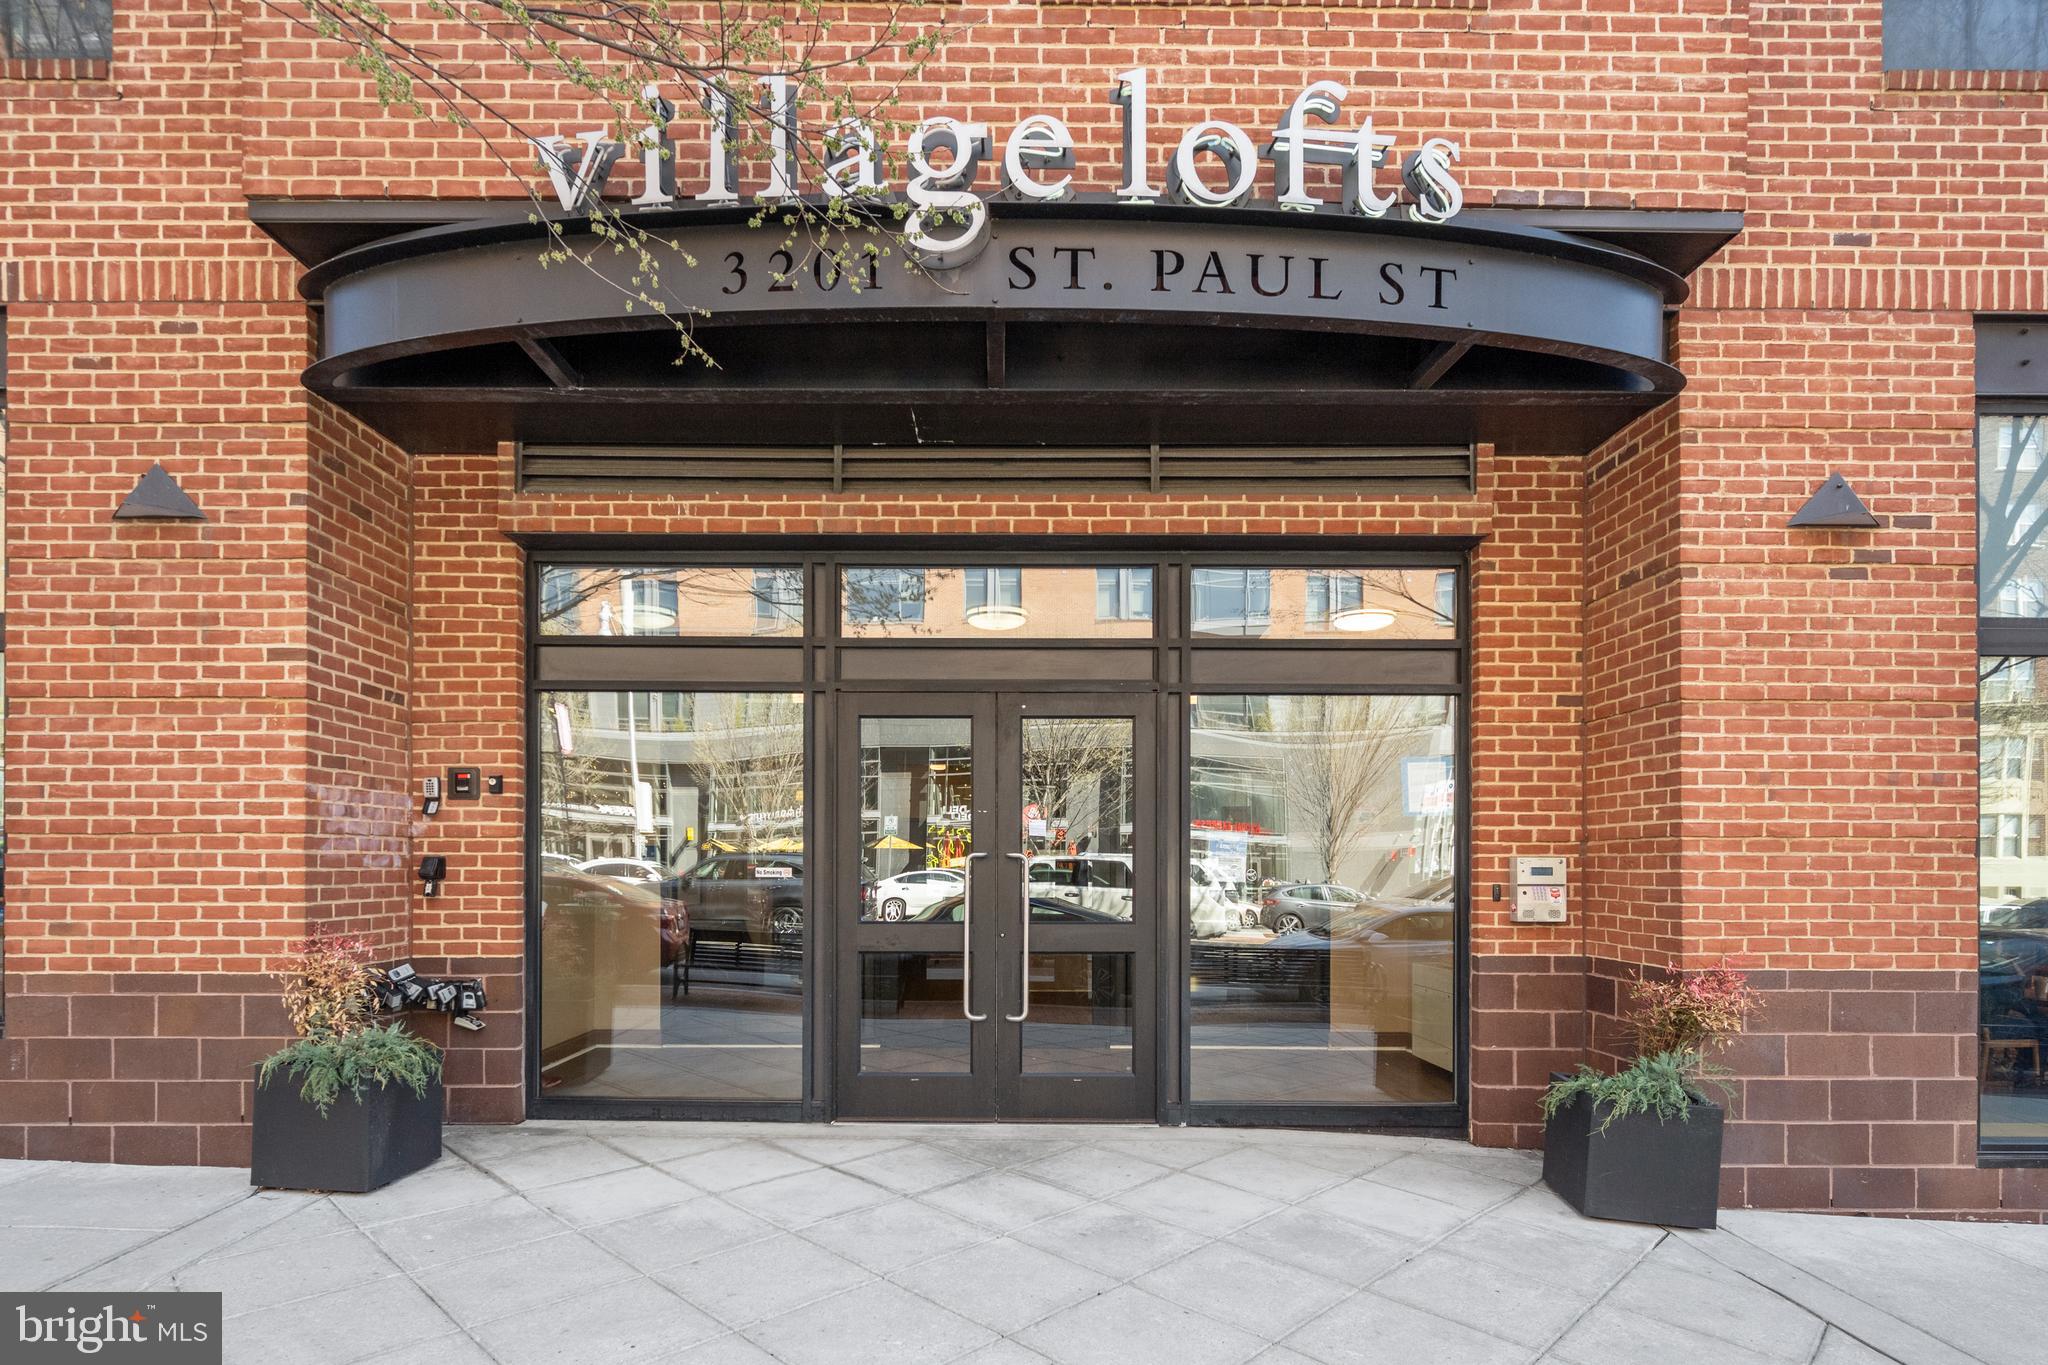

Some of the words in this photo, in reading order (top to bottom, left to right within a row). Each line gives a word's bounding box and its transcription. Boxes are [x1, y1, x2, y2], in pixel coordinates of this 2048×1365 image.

[527, 75, 1074, 252] village
[1116, 67, 1464, 220] lofts
[721, 248, 883, 295] 3201
[1007, 246, 1114, 290] ST.
[1150, 249, 1344, 300] PAUL
[1378, 262, 1458, 310] ST
